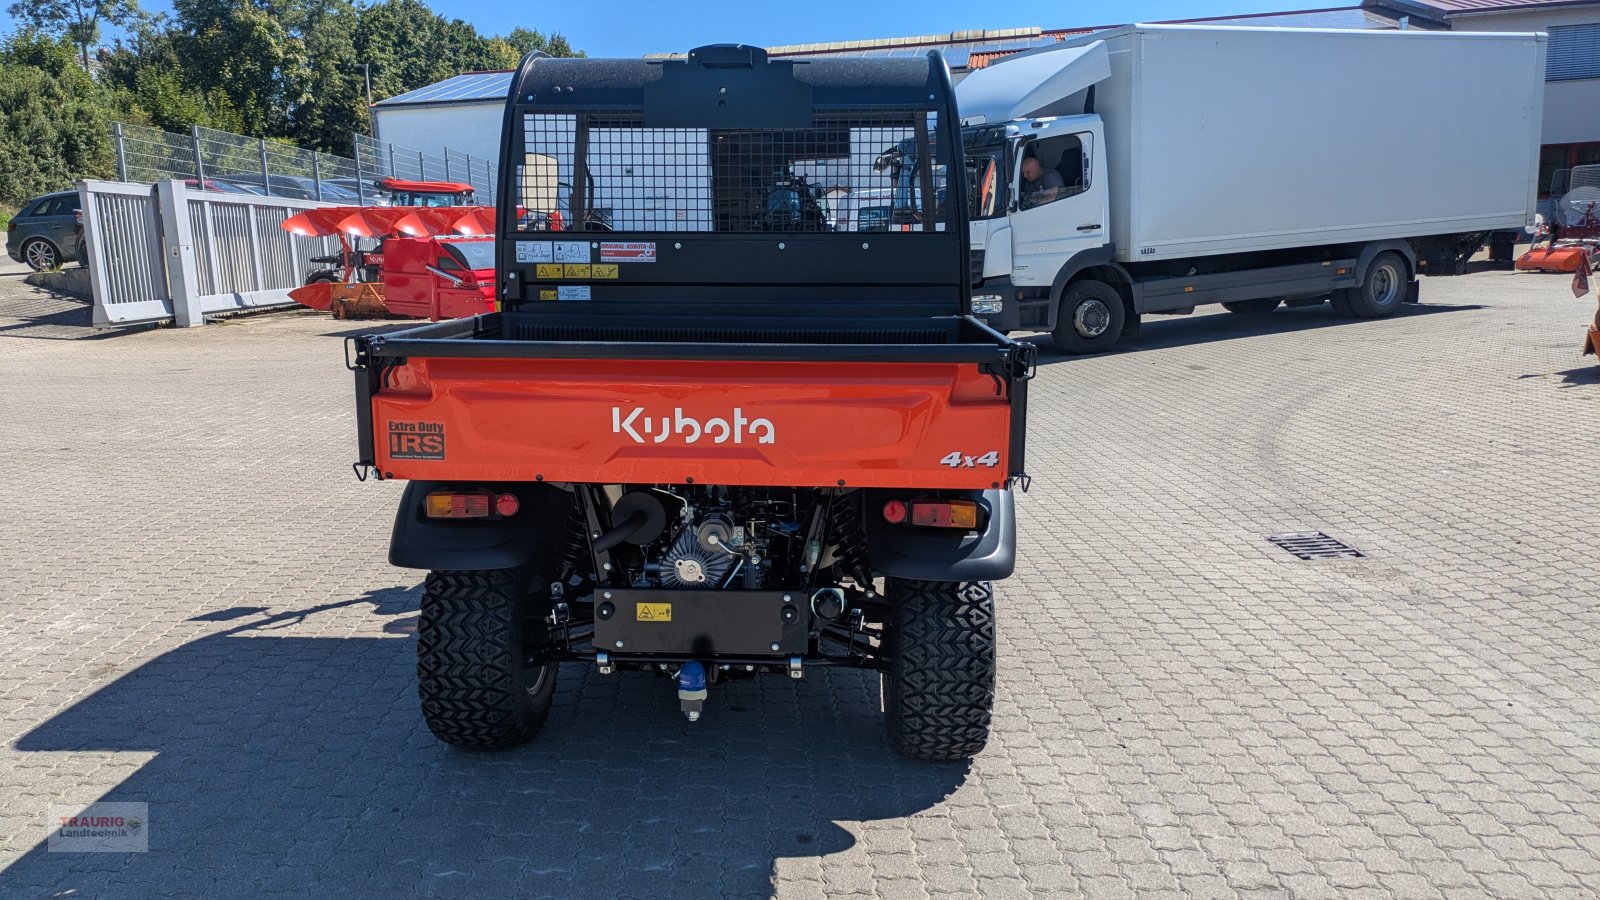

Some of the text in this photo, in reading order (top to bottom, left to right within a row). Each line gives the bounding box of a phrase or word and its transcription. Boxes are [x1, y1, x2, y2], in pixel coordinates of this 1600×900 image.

[388, 421, 444, 432] Extra Duty
[612, 407, 775, 444] Kubota
[391, 435, 443, 453] IRS
[939, 450, 1000, 468] 4x4
